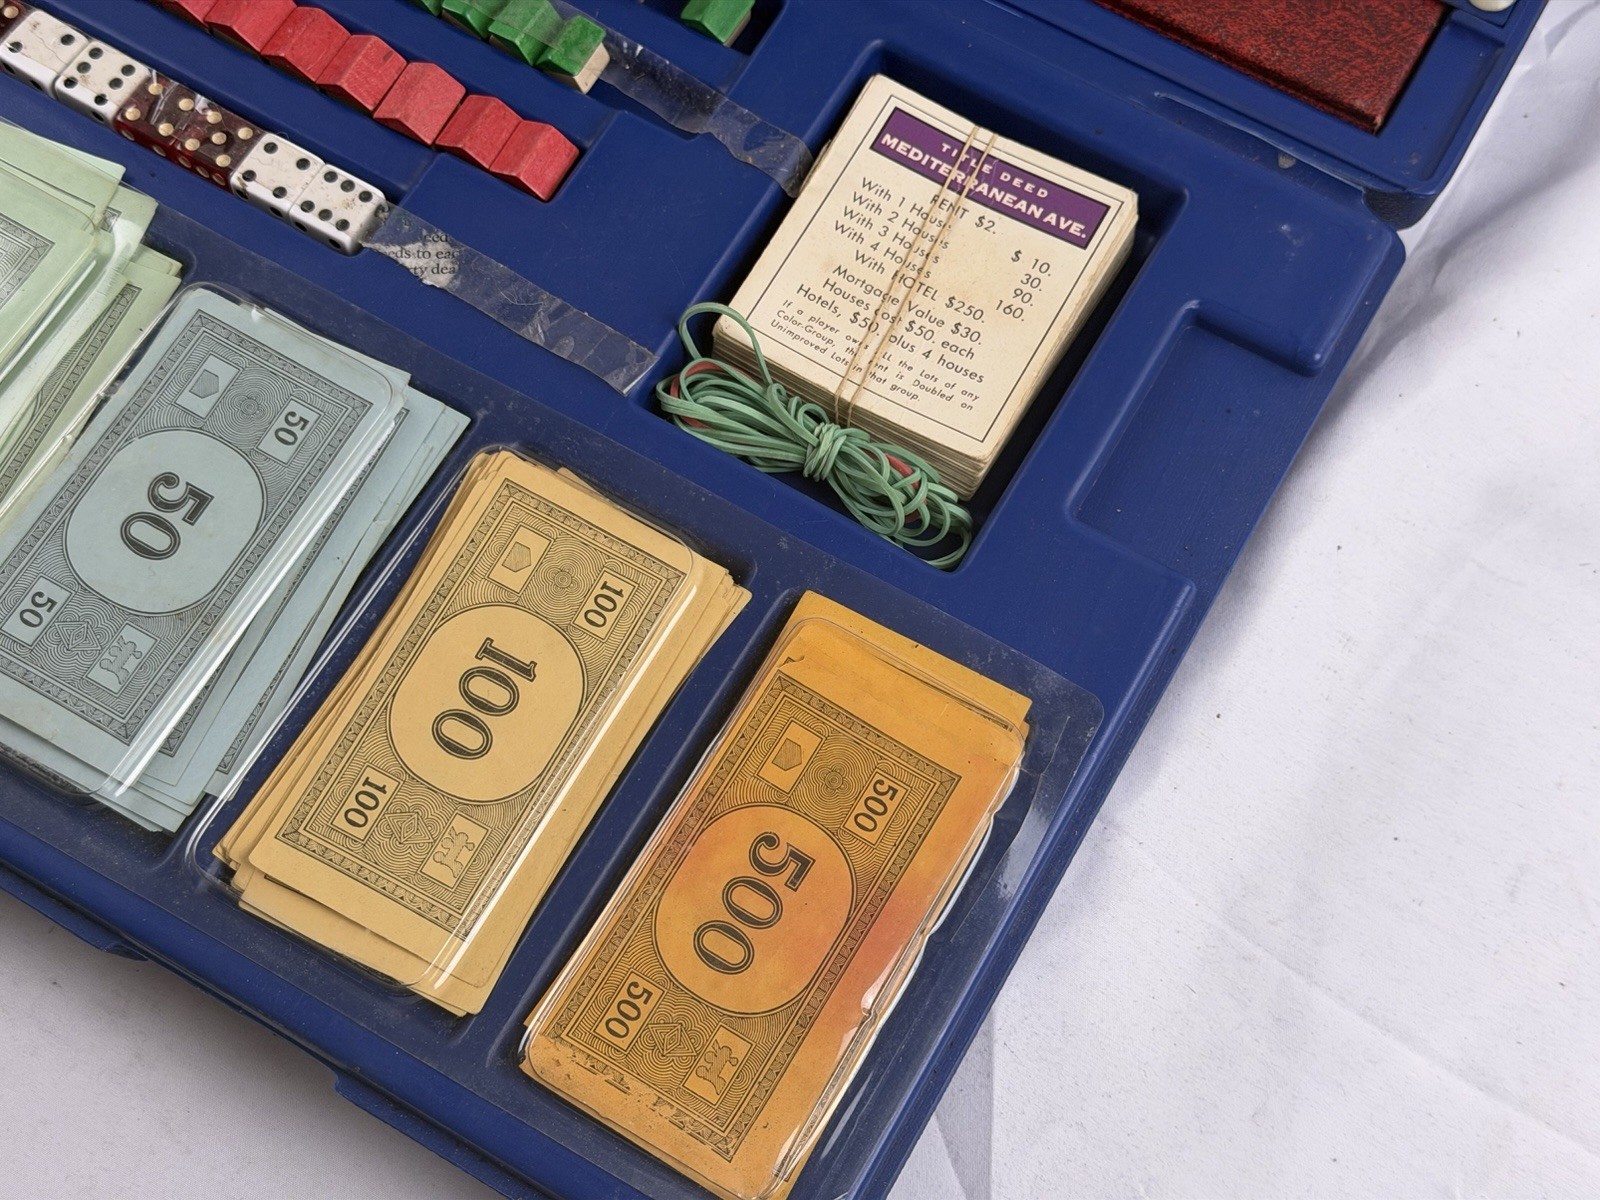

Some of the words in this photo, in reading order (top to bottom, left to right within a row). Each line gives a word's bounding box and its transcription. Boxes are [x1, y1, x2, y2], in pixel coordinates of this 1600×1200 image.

[881, 133, 1045, 219] MEDITERRANEAN
[1042, 212, 1087, 239] AVE.
[941, 142, 993, 174] TITLE
[1000, 172, 1048, 198] DEED
[417, 250, 432, 259] to
[843, 205, 873, 231] With
[878, 226, 890, 238] 3
[1012, 288, 1033, 306] 90.
[853, 191, 883, 216] With
[887, 211, 900, 223] 2
[1020, 273, 1042, 292] 30.
[862, 176, 892, 202] With
[899, 196, 906, 208] 1
[1010, 249, 1021, 263] $
[1031, 259, 1052, 277] 10.
[930, 194, 970, 220] RENT
[975, 215, 997, 235] $2.
[833, 264, 900, 306] Mortgage
[907, 300, 945, 328] Value
[951, 322, 982, 345] $30.
[834, 220, 865, 245] With
[869, 240, 879, 252] 4
[994, 299, 1025, 322] 160.
[855, 249, 885, 275] With
[891, 269, 939, 302] HOTEL
[945, 296, 985, 324] $250.
[770, 319, 828, 355] Unimproved
[830, 351, 850, 366] Lots
[852, 362, 863, 373] in
[889, 384, 920, 402] group.
[776, 309, 835, 348] Color-Group,
[897, 371, 905, 380] is
[912, 378, 954, 402] Doubled
[960, 401, 974, 411] on
[782, 300, 793, 309] If
[796, 308, 804, 316] a
[807, 315, 841, 335] player
[898, 360, 914, 373] the
[919, 369, 939, 384] Lots
[944, 381, 958, 391] of
[961, 389, 980, 402] any
[796, 283, 842, 318] Hotels,
[849, 311, 880, 337] $50.
[921, 349, 932, 360] 4
[937, 353, 985, 384] houses
[823, 278, 870, 311] Houses
[905, 320, 935, 344] $50.
[941, 340, 975, 361] each
[274, 409, 310, 446] 50
[120, 471, 215, 561] 50
[19, 590, 58, 627] 50
[583, 578, 625, 629] 100
[432, 636, 538, 761] 100
[343, 775, 388, 829] 100
[852, 778, 899, 833] 500
[693, 830, 817, 975] 500
[605, 980, 653, 1039] 500
